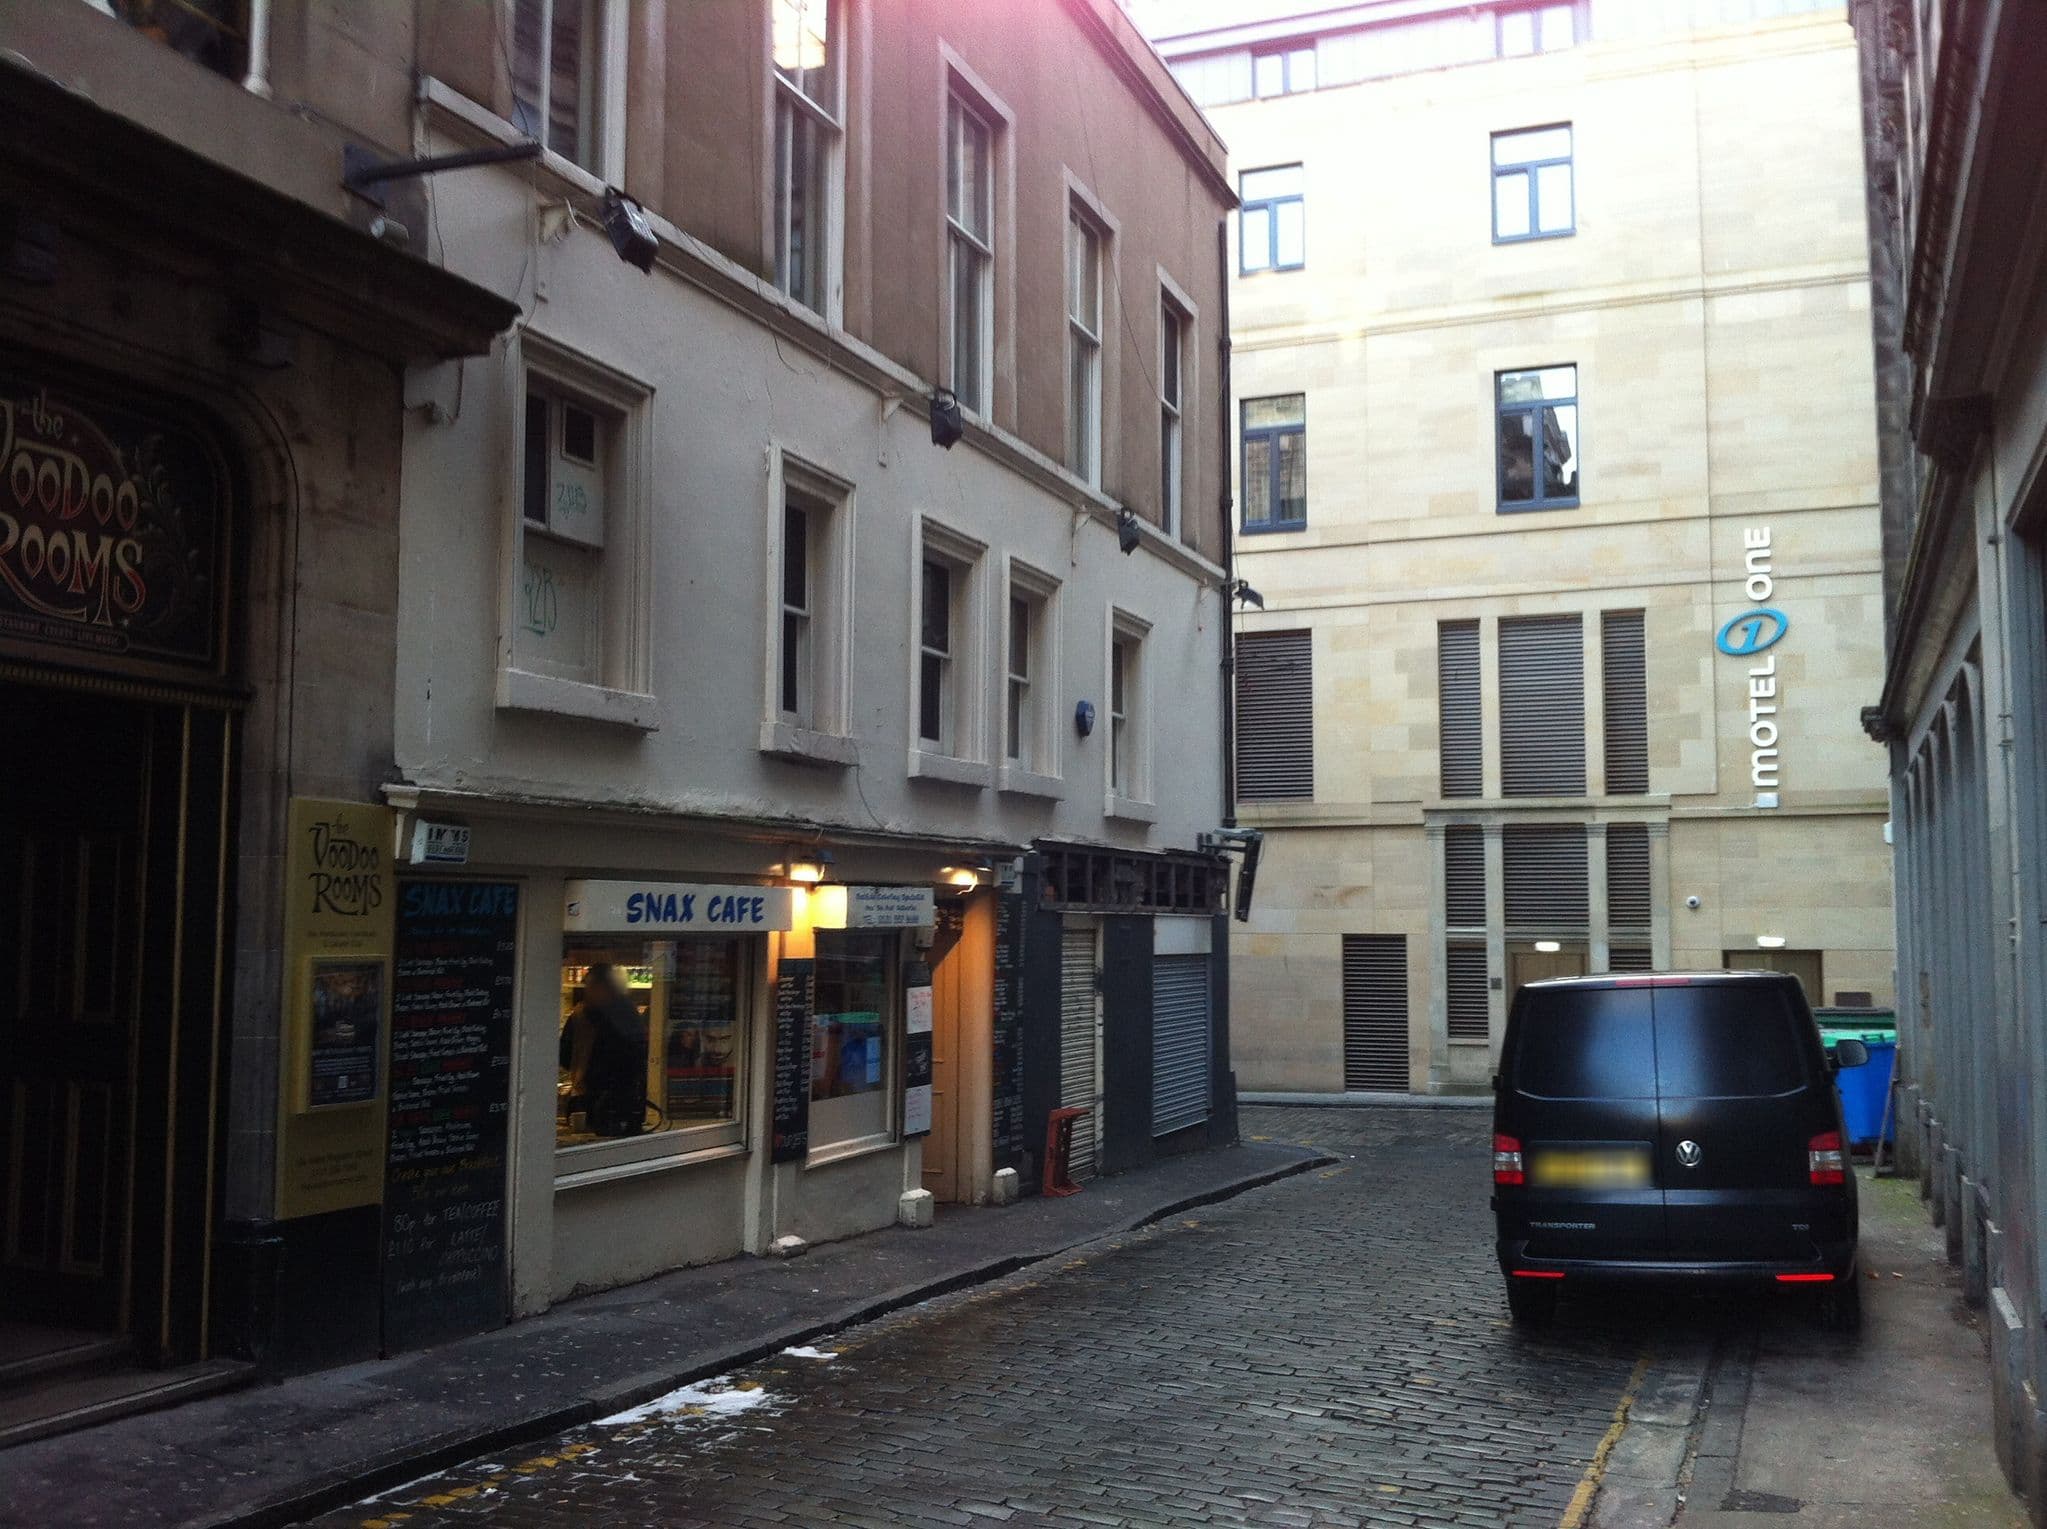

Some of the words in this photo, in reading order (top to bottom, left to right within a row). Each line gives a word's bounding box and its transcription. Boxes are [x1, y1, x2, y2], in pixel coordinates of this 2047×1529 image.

[308, 873, 382, 916] ROOMS
[626, 892, 696, 923] SNAX
[707, 895, 764, 923] CAFE
[1529, 1222, 1596, 1230] TRANSPORTER
